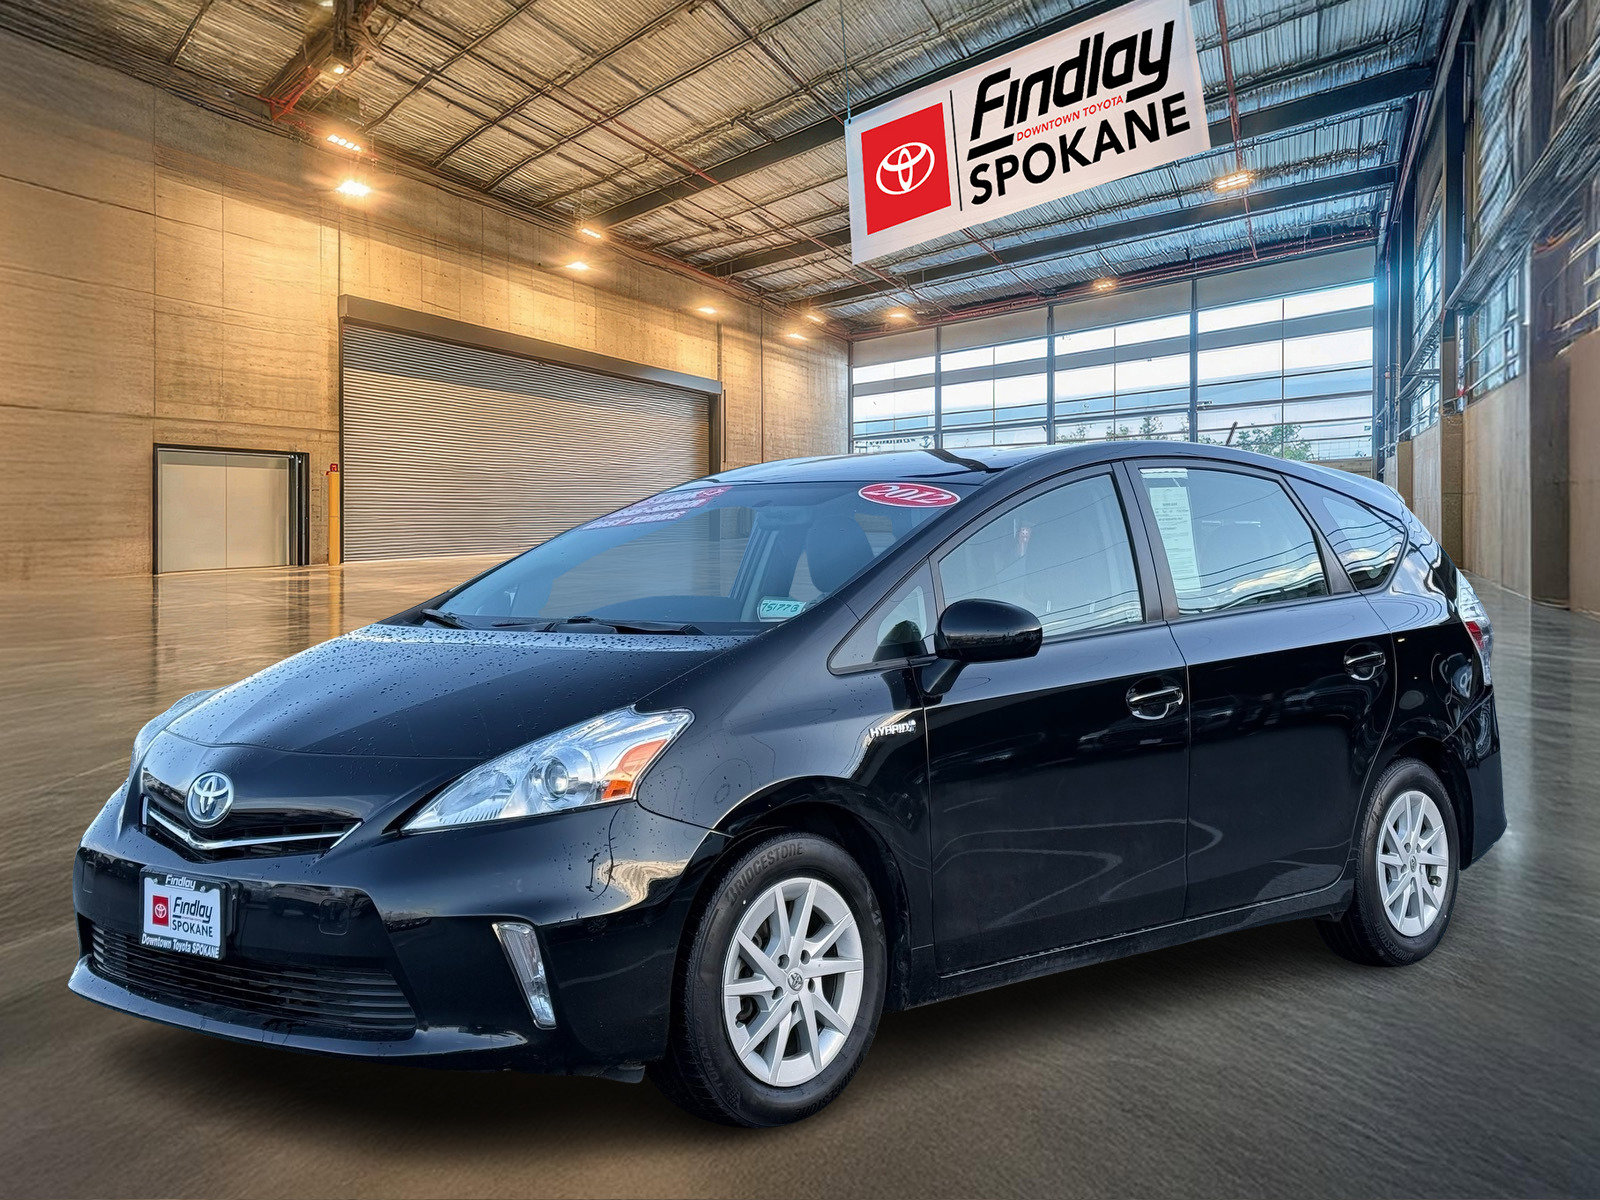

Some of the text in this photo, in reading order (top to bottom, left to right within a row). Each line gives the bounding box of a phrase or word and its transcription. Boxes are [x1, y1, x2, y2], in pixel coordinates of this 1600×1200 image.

[969, 19, 1175, 142] Findlay
[1016, 94, 1125, 143] DOWNTOWN TOYOTA
[969, 91, 1191, 206] SPOKANE
[862, 485, 952, 504] 2012
[869, 722, 912, 738] HYBRID
[165, 874, 196, 891] Findlay
[725, 843, 804, 907] BRIDGESTONE
[173, 897, 213, 924] Findlay
[172, 919, 213, 938] SPOKANE
[141, 933, 219, 959] Downtown Toyota SPOKANE
